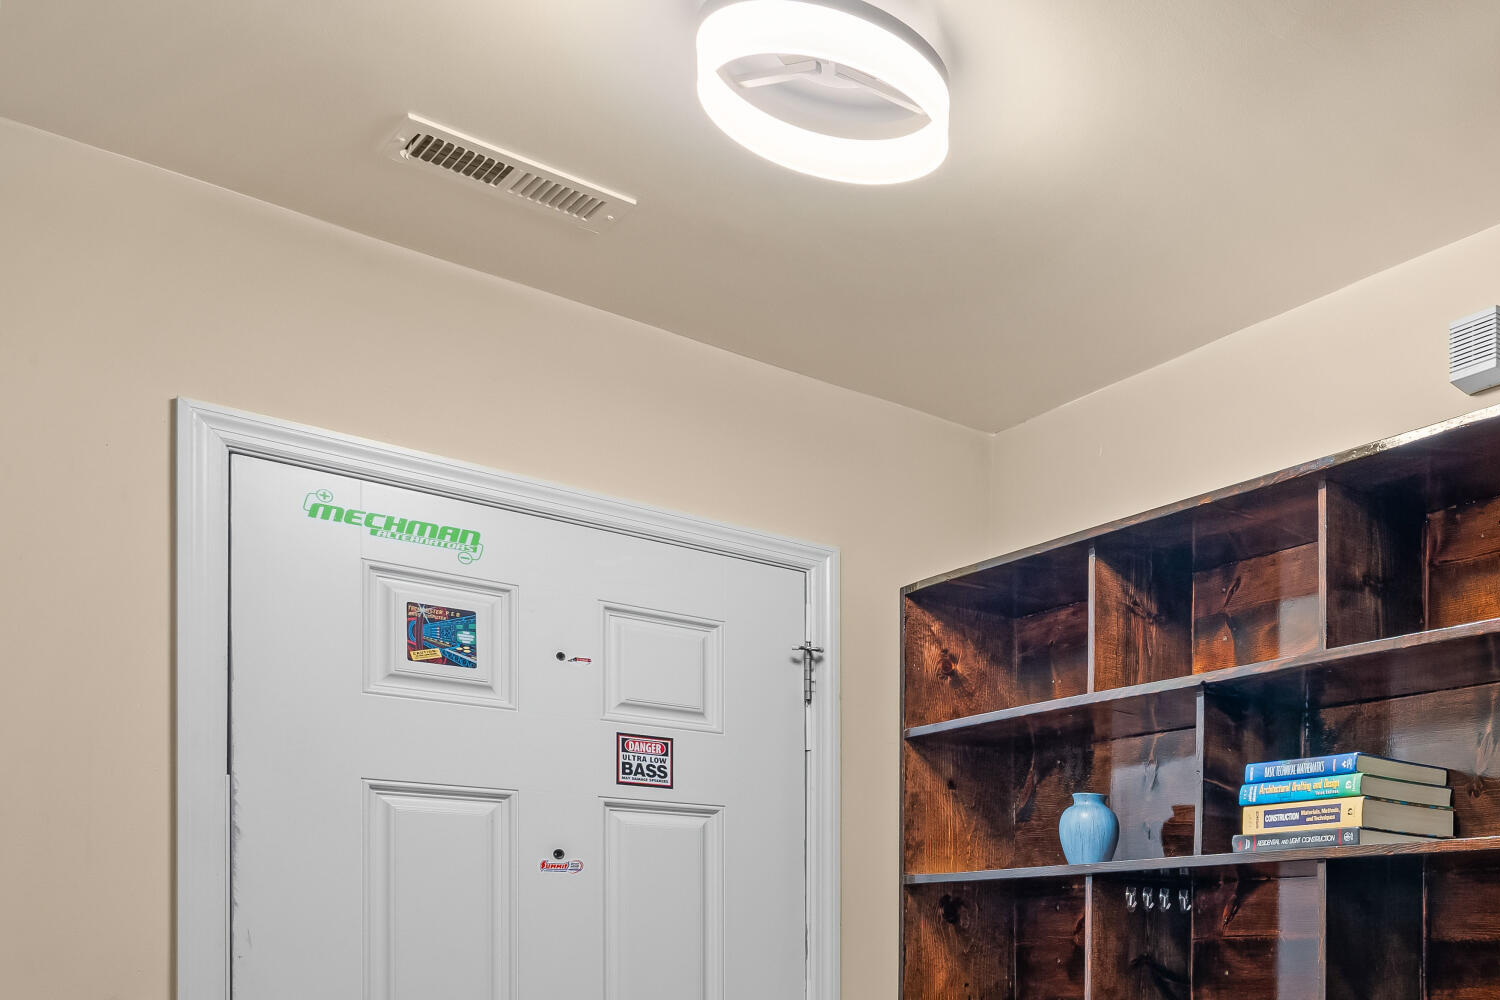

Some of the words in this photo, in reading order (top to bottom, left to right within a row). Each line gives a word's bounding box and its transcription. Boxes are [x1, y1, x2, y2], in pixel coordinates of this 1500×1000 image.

[308, 503, 481, 545] MECHMAN
[628, 741, 662, 754] DANGER
[622, 754, 647, 762] ULTRA
[622, 761, 668, 779] BASS
[1259, 783, 1290, 794] Architectural
[1291, 781, 1312, 793] Drafting
[1313, 780, 1323, 789] and
[1323, 778, 1340, 790] Design
[1264, 812, 1300, 823] CONSTRUCTION
[1301, 835, 1336, 844] CONSTRUCTION
